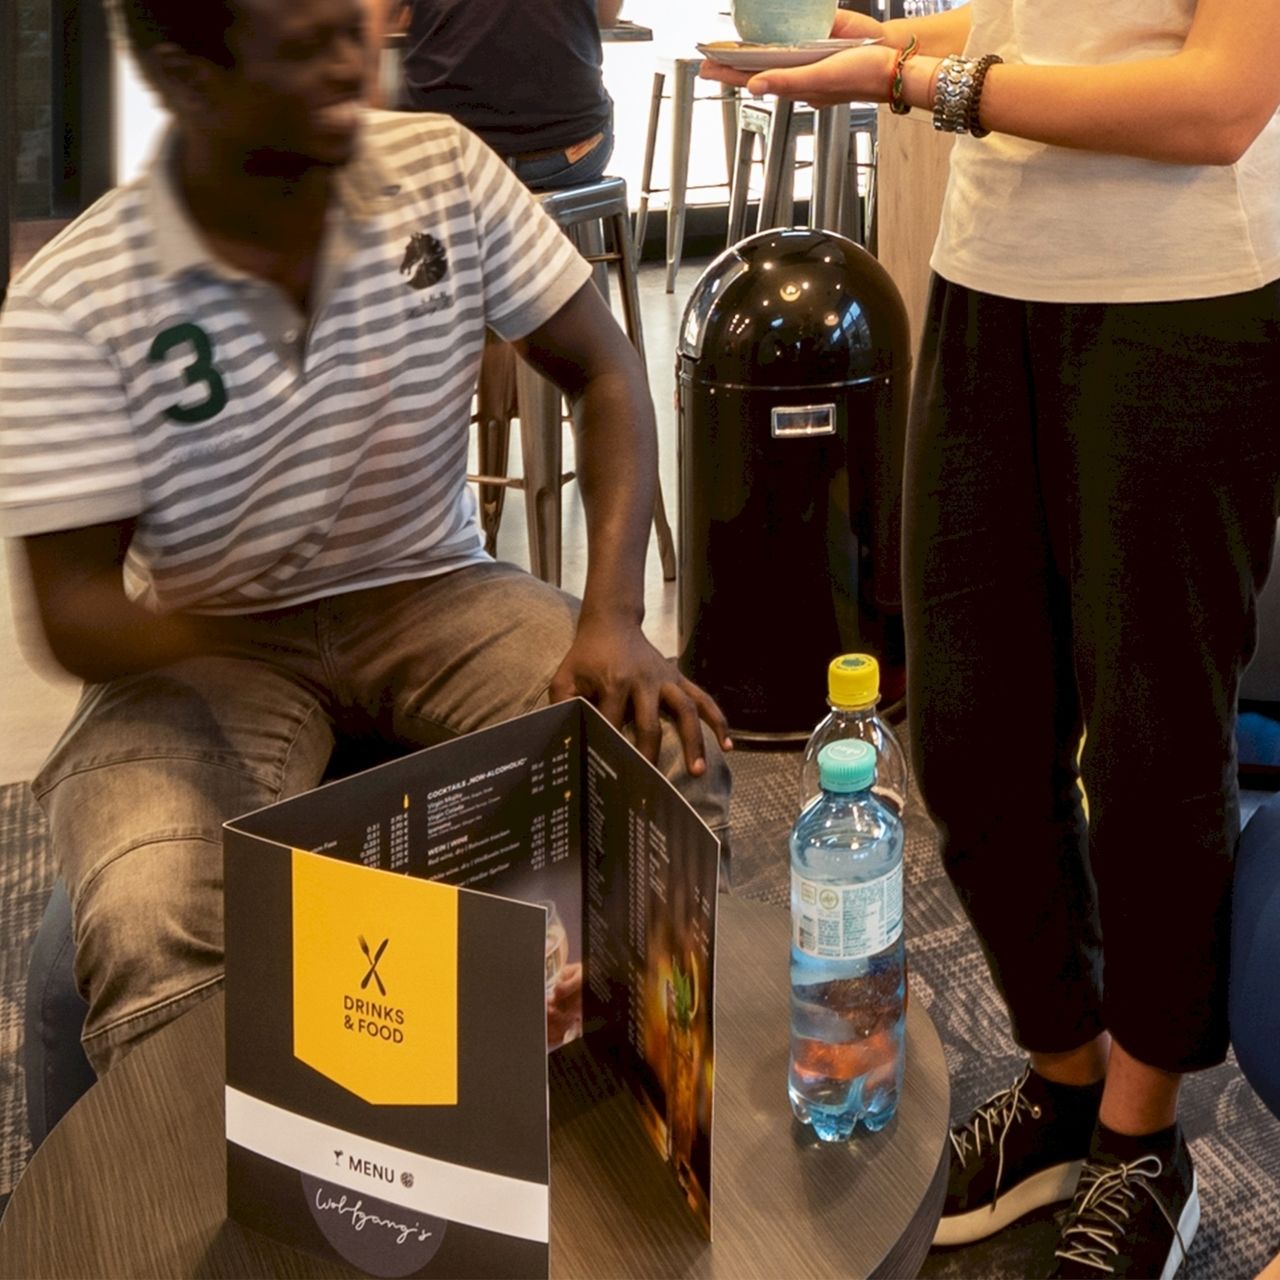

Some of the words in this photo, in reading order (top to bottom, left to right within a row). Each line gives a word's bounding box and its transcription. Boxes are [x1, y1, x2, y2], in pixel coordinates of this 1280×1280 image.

[147, 322, 227, 425] 3
[344, 995, 405, 1026] DRINKS
[344, 1014, 355, 1031] &
[358, 1019, 405, 1044] FOOD
[348, 1155, 395, 1184] MENU
